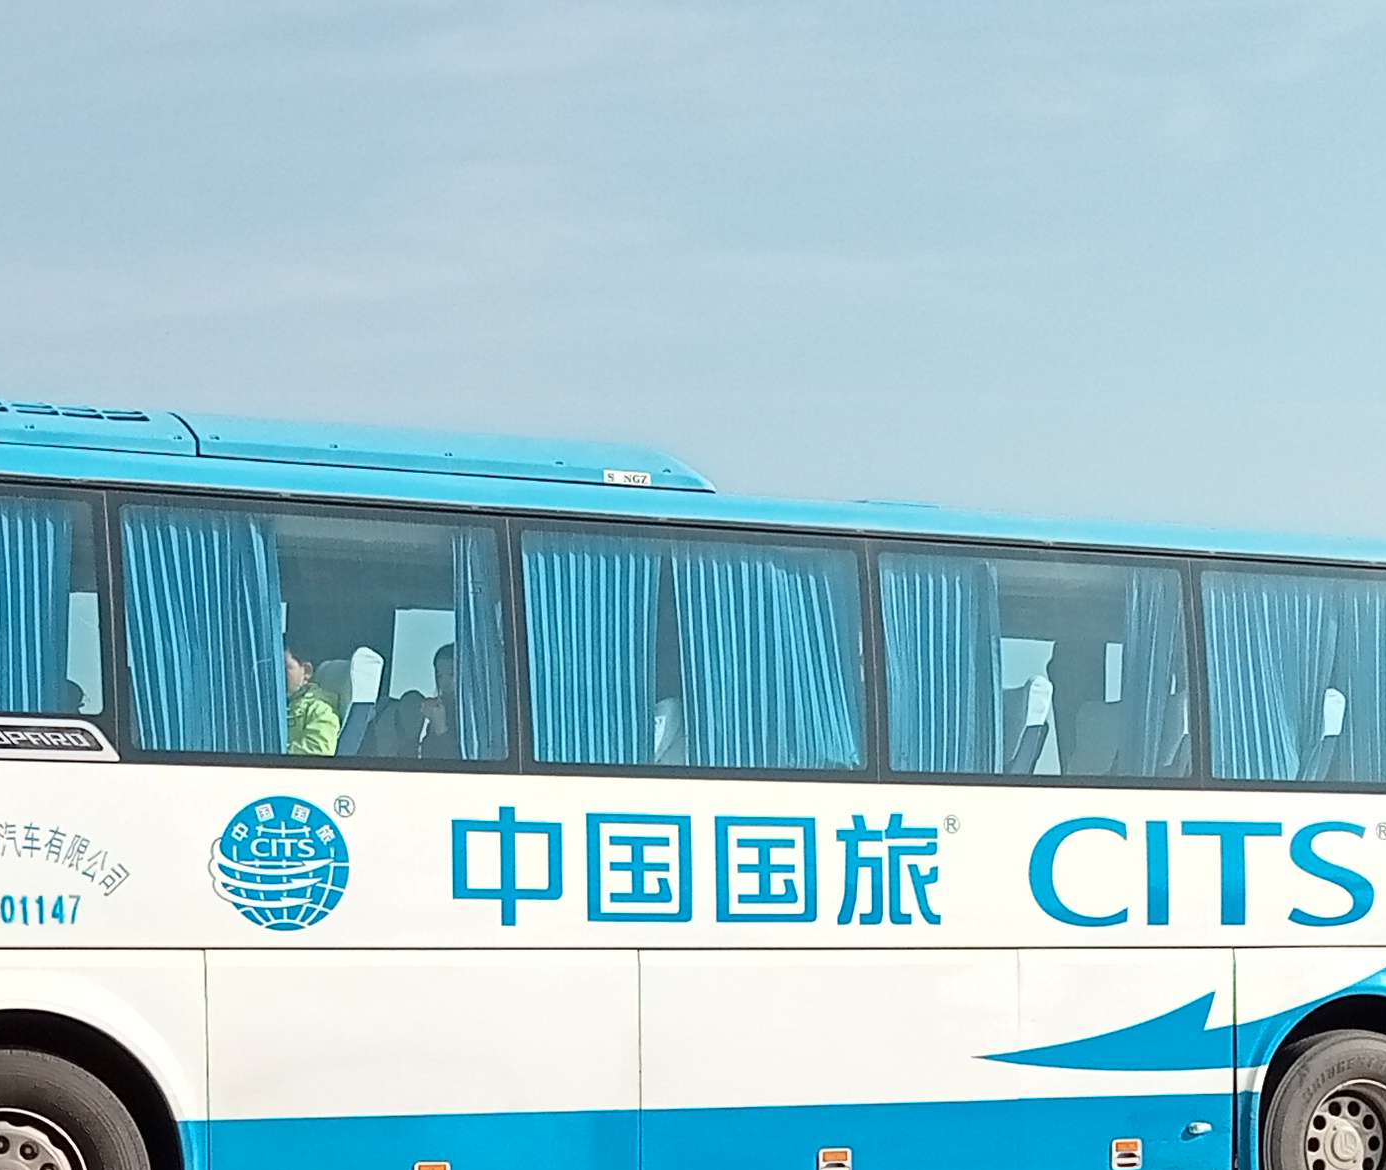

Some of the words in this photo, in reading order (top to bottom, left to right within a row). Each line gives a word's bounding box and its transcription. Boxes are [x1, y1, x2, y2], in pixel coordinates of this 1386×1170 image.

[607, 473, 648, 484] SNGZ
[250, 838, 316, 858] CITS
[451, 806, 941, 927] 中国国旅
[1029, 816, 1375, 928] CITS
